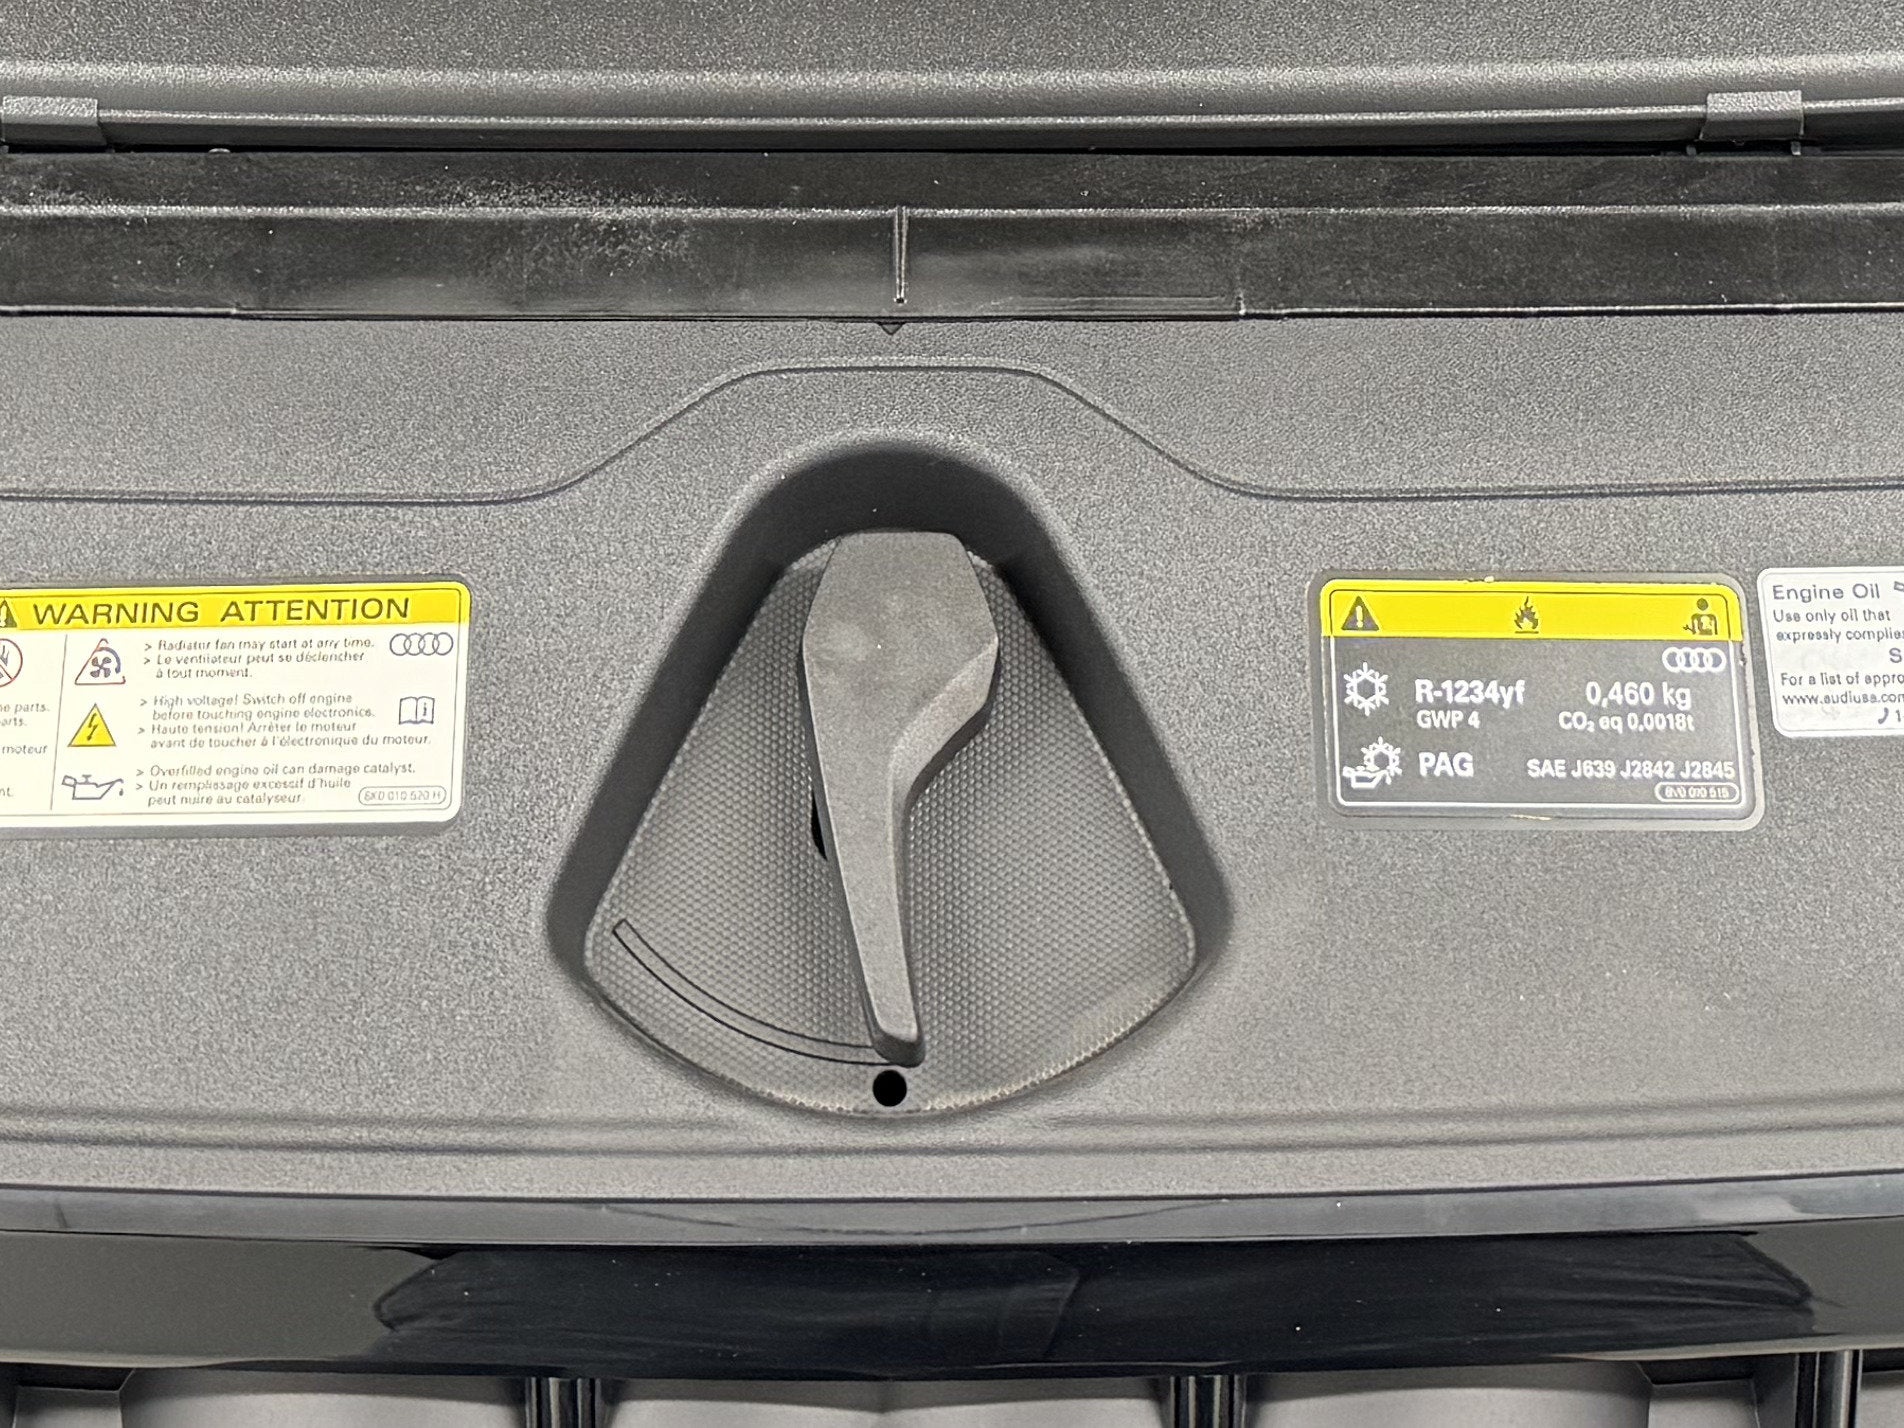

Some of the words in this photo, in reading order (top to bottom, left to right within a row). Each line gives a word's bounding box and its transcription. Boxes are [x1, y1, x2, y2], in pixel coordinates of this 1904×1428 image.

[1772, 584, 1844, 603] Engine
[1852, 583, 1880, 599] Oil
[33, 602, 199, 625] WARNING
[220, 598, 409, 622] ATTENTION
[1773, 610, 1801, 622] Use
[1806, 609, 1836, 624] only
[1841, 609, 1857, 621] oil
[1863, 609, 1891, 621] that
[1777, 628, 1841, 643] expressly
[158, 639, 211, 650] Radiator
[214, 639, 235, 649] fan
[238, 640, 265, 652] may
[269, 638, 298, 649] start
[301, 639, 314, 649] at
[157, 654, 171, 664] Le
[176, 653, 243, 664] ventilateur
[246, 654, 274, 665] peut
[278, 654, 292, 662] se
[167, 668, 192, 678] tout
[196, 668, 252, 678] moment.
[1780, 672, 1803, 686] For
[1820, 672, 1842, 685] list
[1846, 672, 1859, 684] of
[1415, 679, 1526, 709] R-1234yf
[1586, 681, 1654, 708] 0,460
[1662, 681, 1692, 711] kg
[14, 703, 50, 715] parts.
[154, 695, 183, 710] High
[187, 694, 238, 707] voltage!
[243, 694, 285, 705] Switch
[289, 694, 306, 704] off
[310, 695, 352, 706] engine
[152, 709, 193, 720] before
[197, 708, 252, 721] touching
[257, 709, 300, 720] engine
[304, 707, 376, 718] electronics.
[1416, 710, 1464, 728] GWP
[1467, 710, 1480, 729] 4
[151, 723, 188, 734] Haute
[193, 723, 244, 734] tension!
[296, 721, 307, 732] le
[311, 722, 357, 732] moteur
[1598, 716, 1623, 734] eq
[150, 738, 185, 749] avant
[189, 737, 205, 748] de
[209, 736, 257, 748] toucher
[362, 734, 378, 745] du
[2, 744, 48, 755] moteur
[150, 765, 212, 777] Overfilled
[216, 765, 259, 777] engine
[263, 764, 278, 775] oil
[282, 765, 305, 774] can
[309, 764, 360, 776] damage
[363, 763, 416, 775] catalyst.
[1419, 751, 1474, 777] PAG
[1526, 759, 1566, 778] SAE
[1571, 759, 1616, 778] J639
[1620, 759, 1675, 778] J2842
[1680, 759, 1735, 779] J2845
[149, 780, 167, 791] Un
[172, 780, 249, 793] remplissage
[253, 778, 304, 789] excessif
[308, 778, 351, 789] d'huile
[148, 794, 177, 807] peut
[181, 794, 212, 805] nuire
[217, 795, 232, 804] au
